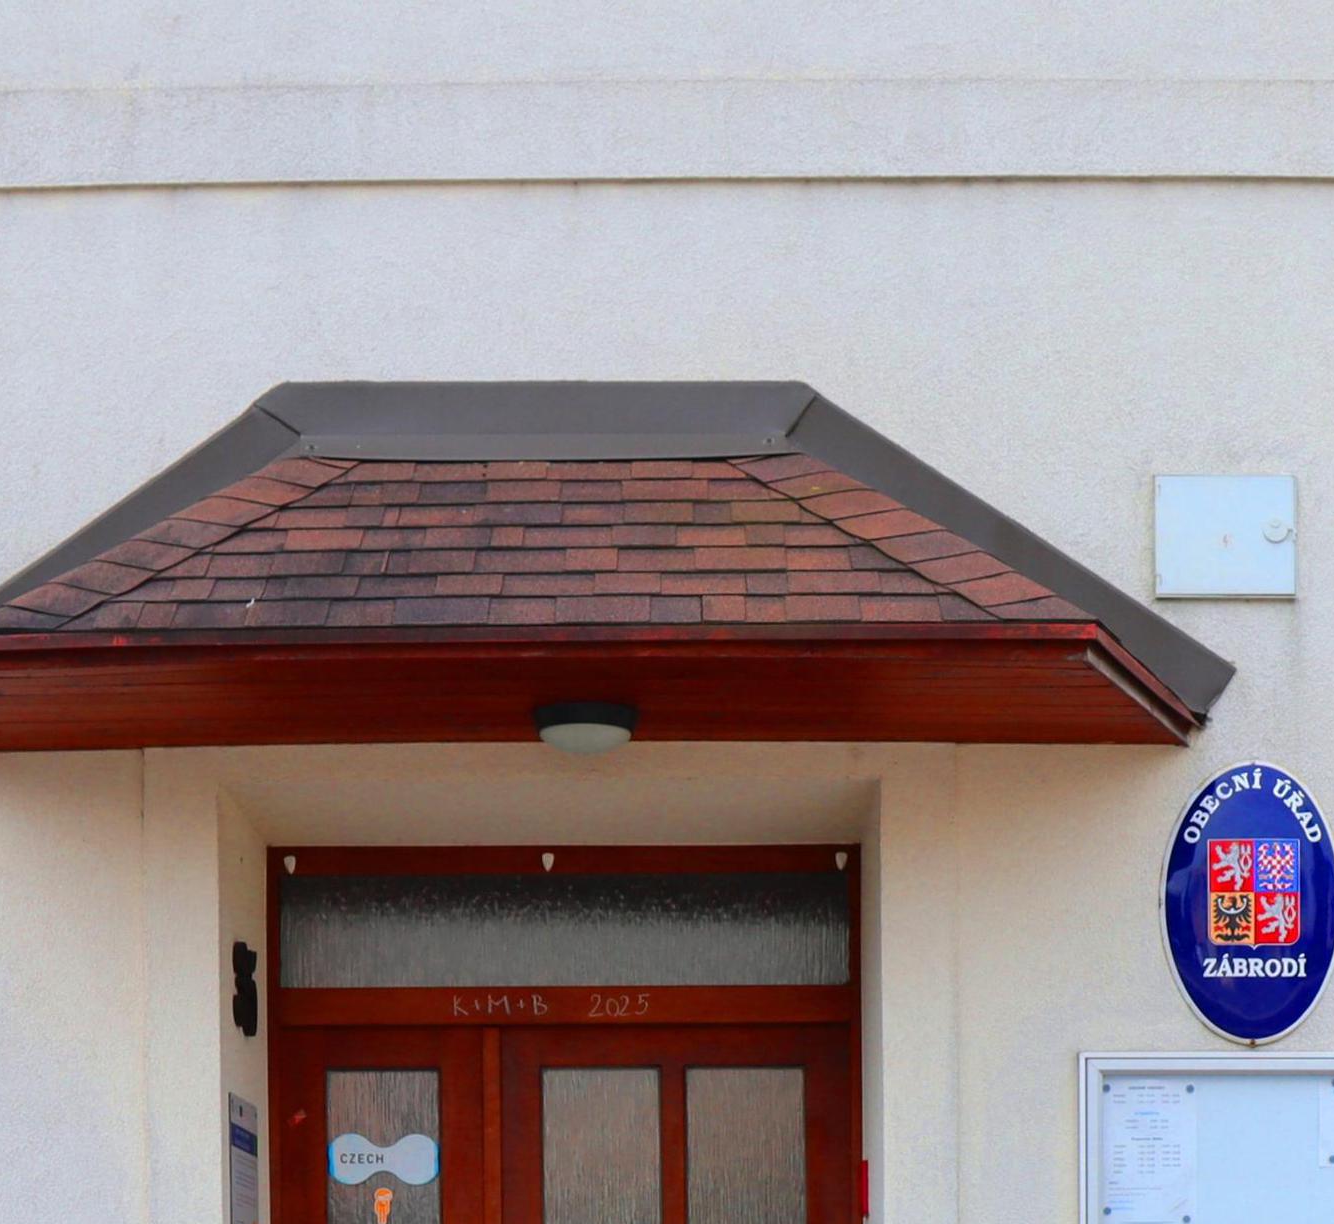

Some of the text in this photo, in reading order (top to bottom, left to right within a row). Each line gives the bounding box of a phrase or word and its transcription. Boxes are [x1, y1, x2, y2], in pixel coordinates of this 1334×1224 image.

[1183, 768, 1323, 845] OBECNÍ ÚŘAD
[1203, 952, 1307, 978] ZÁBRODÍ
[588, 993, 651, 1017] 2025
[340, 1153, 384, 1164] CZECH
